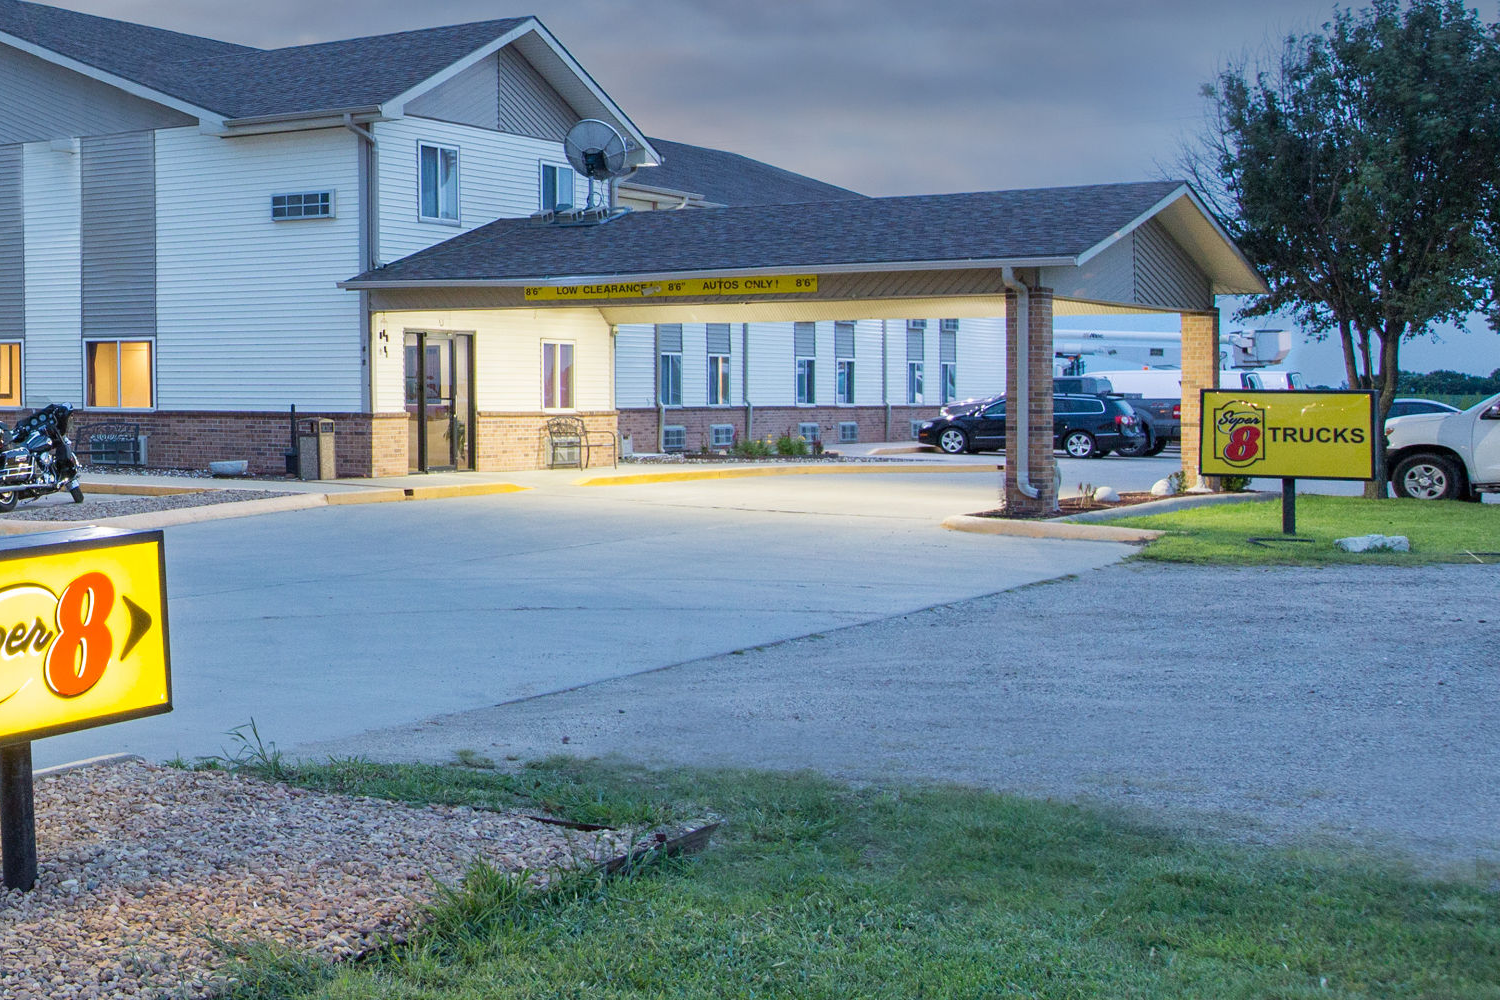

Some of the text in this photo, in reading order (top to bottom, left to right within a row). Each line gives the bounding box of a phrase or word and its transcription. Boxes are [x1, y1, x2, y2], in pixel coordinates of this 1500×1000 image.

[556, 286, 578, 295] LOW
[702, 280, 739, 290] AUTOS
[1218, 410, 1261, 432] Super
[1223, 426, 1261, 461] 8
[1268, 427, 1365, 443] TRUCKS
[43, 572, 115, 698] 8
